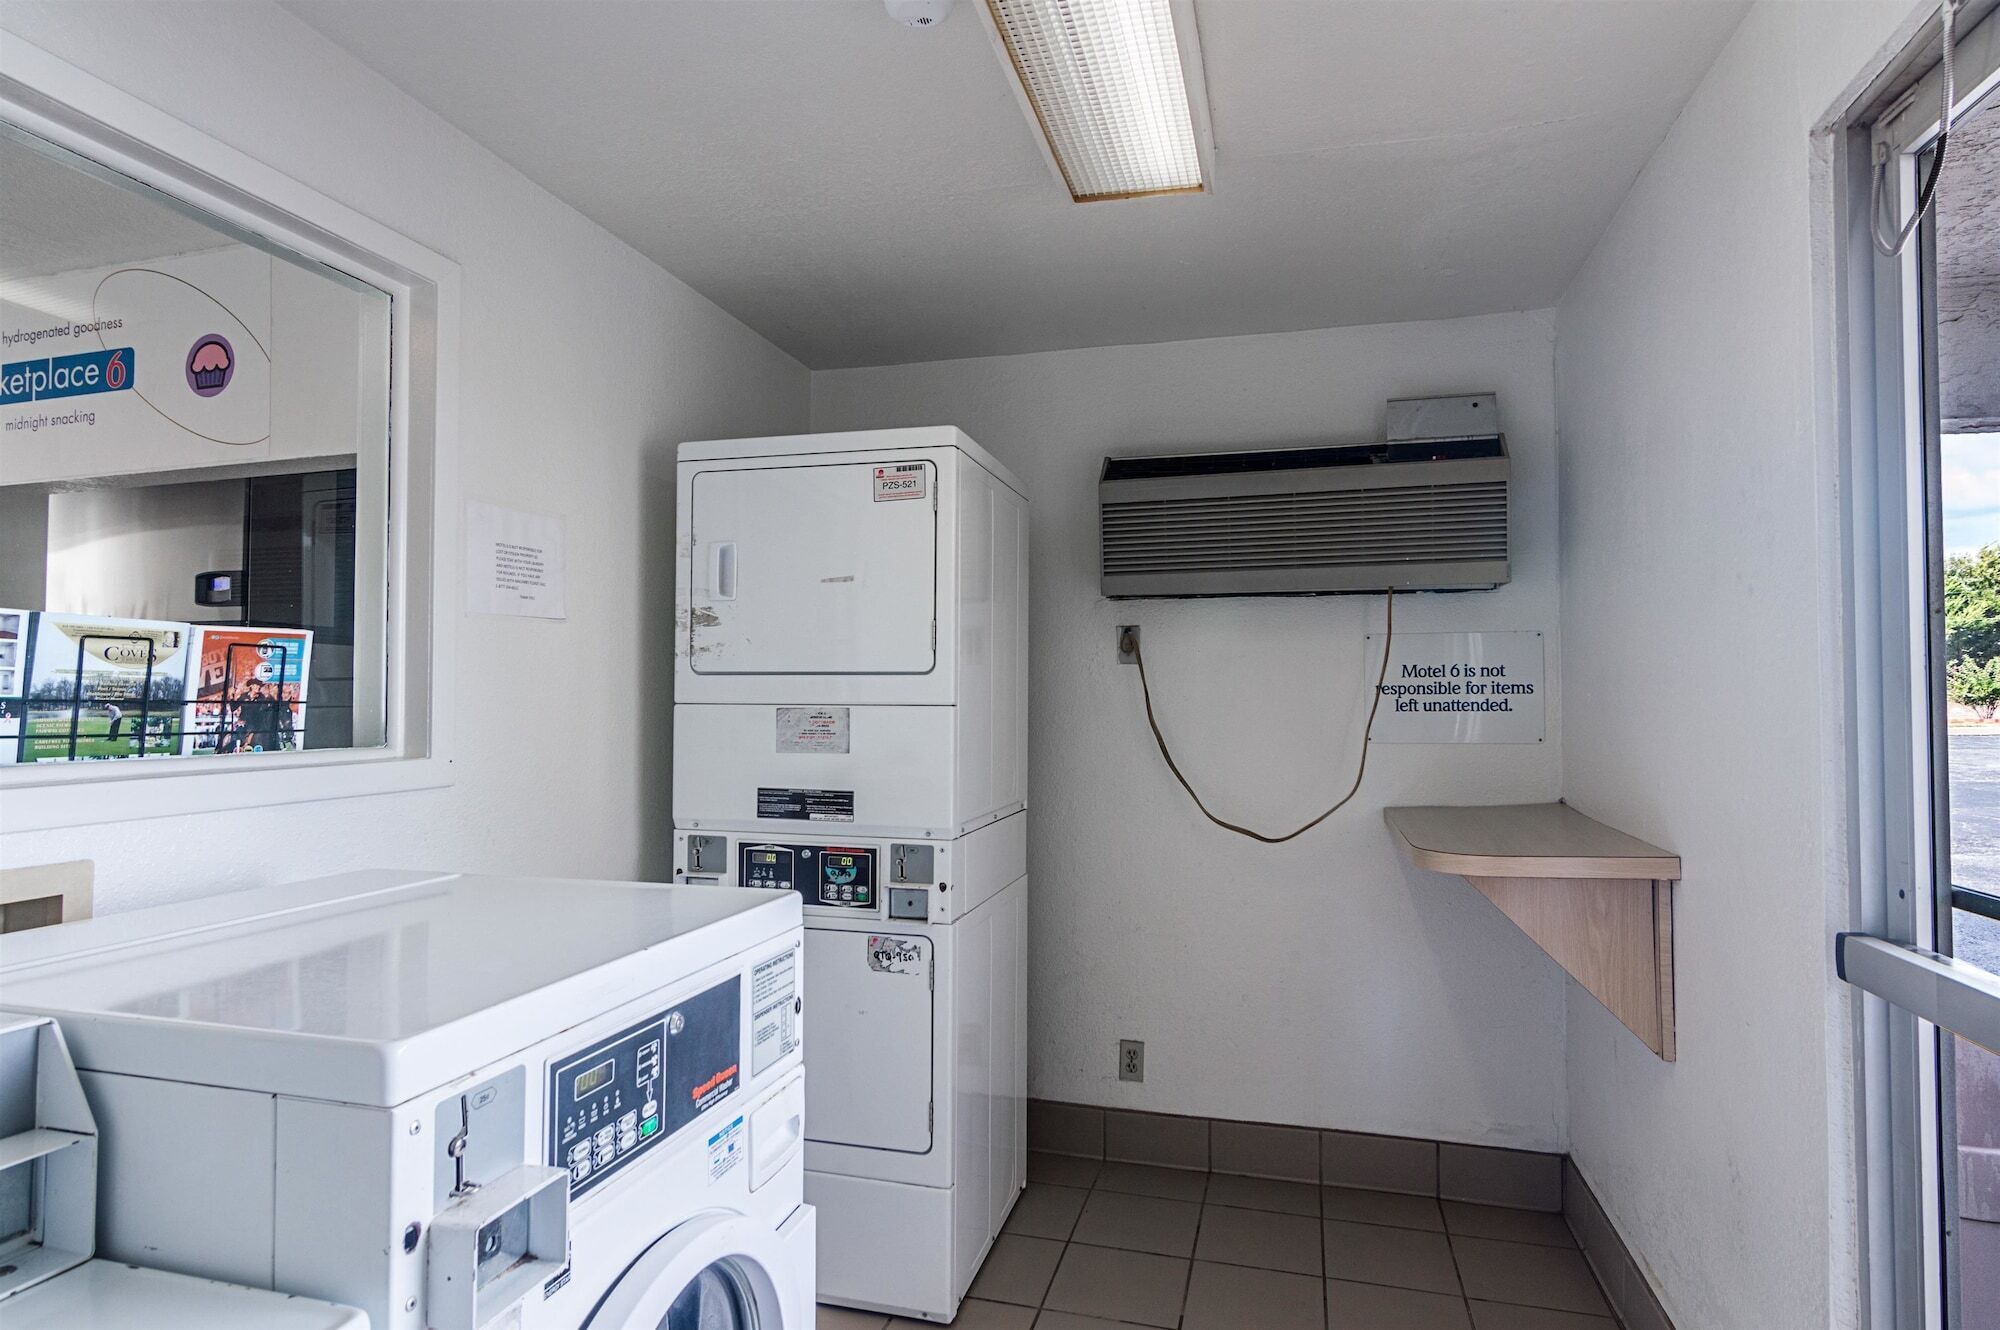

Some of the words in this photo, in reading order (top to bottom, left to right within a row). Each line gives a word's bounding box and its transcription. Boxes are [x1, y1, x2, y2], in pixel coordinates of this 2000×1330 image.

[2, 321, 70, 347] hydrogenated
[74, 317, 123, 338] goodness
[105, 350, 127, 389] 6
[5, 414, 48, 431] midnight
[51, 409, 96, 425] snacking
[882, 480, 917, 490] PZS-521
[1401, 664, 1446, 678] Motel
[1450, 664, 1460, 678] 6
[1464, 664, 1476, 678] is
[1480, 664, 1506, 677] not
[1465, 681, 1488, 694] for
[1491, 682, 1534, 694] items
[1395, 698, 1419, 712] left
[1423, 698, 1513, 712] unattended.
[841, 857, 853, 865] 00
